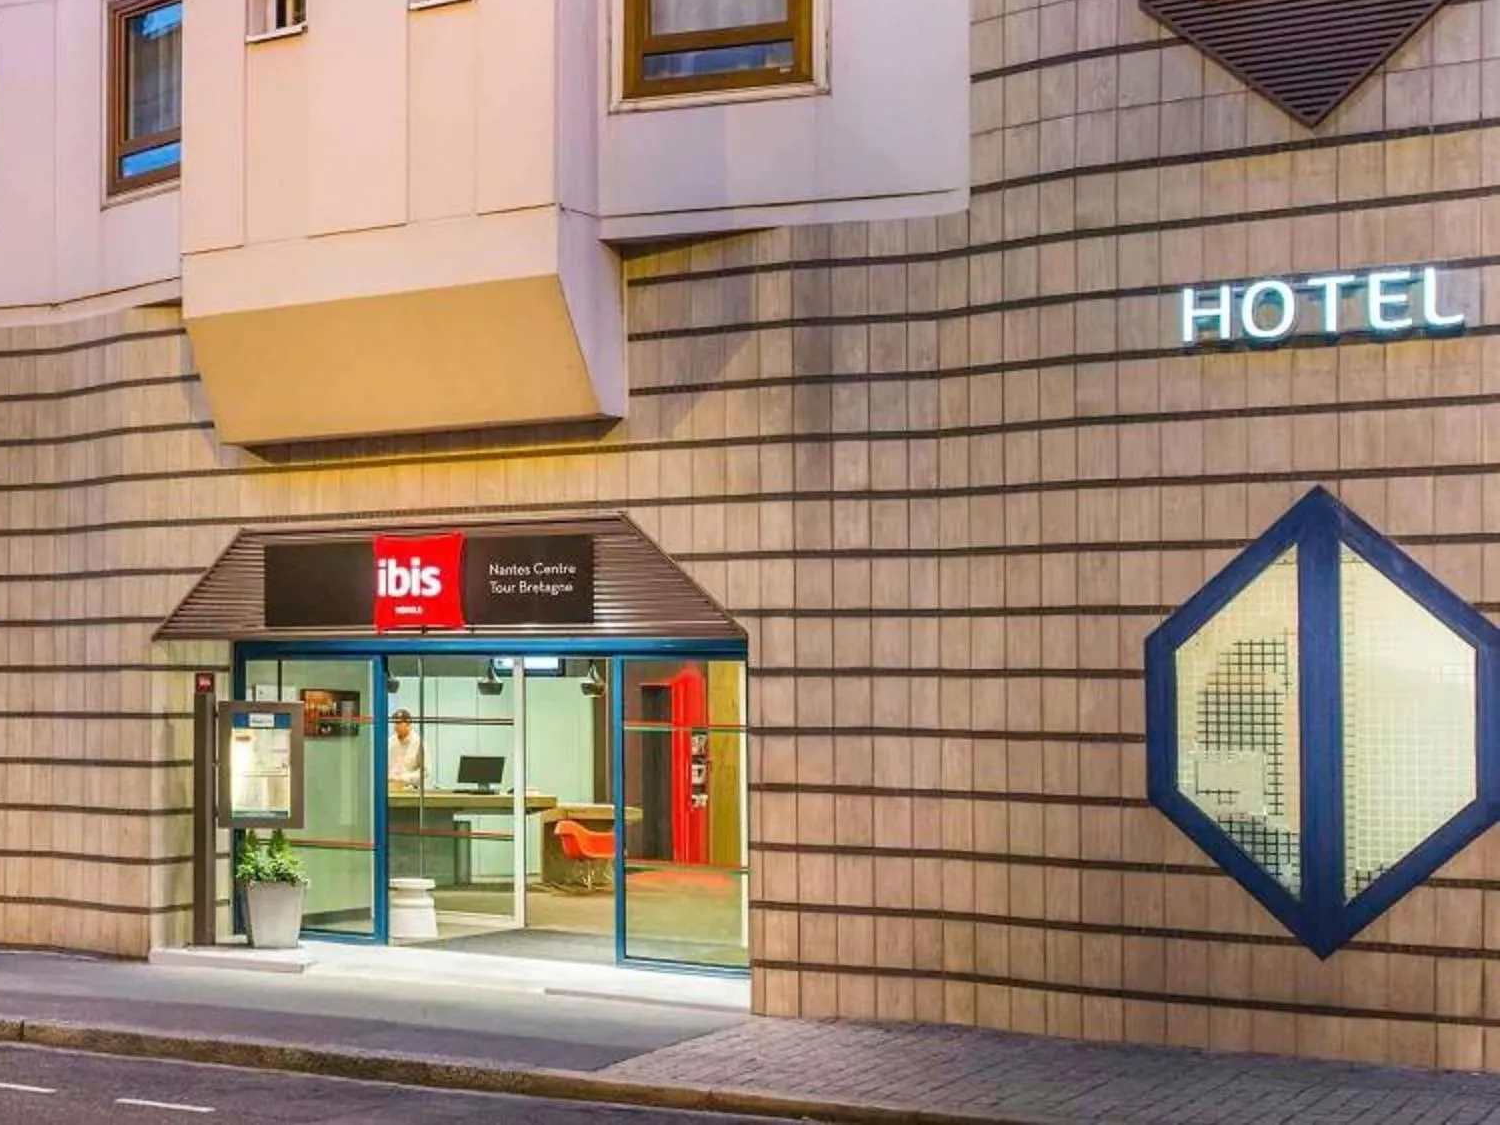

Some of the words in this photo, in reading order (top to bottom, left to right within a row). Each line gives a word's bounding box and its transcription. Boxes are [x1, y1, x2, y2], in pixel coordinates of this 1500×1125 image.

[1182, 266, 1465, 342] HOTEL
[377, 557, 442, 597] ibis
[489, 563, 530, 575] Nantes
[533, 562, 576, 575] Centre
[489, 580, 516, 594] Tour
[519, 580, 573, 596] Bretagne
